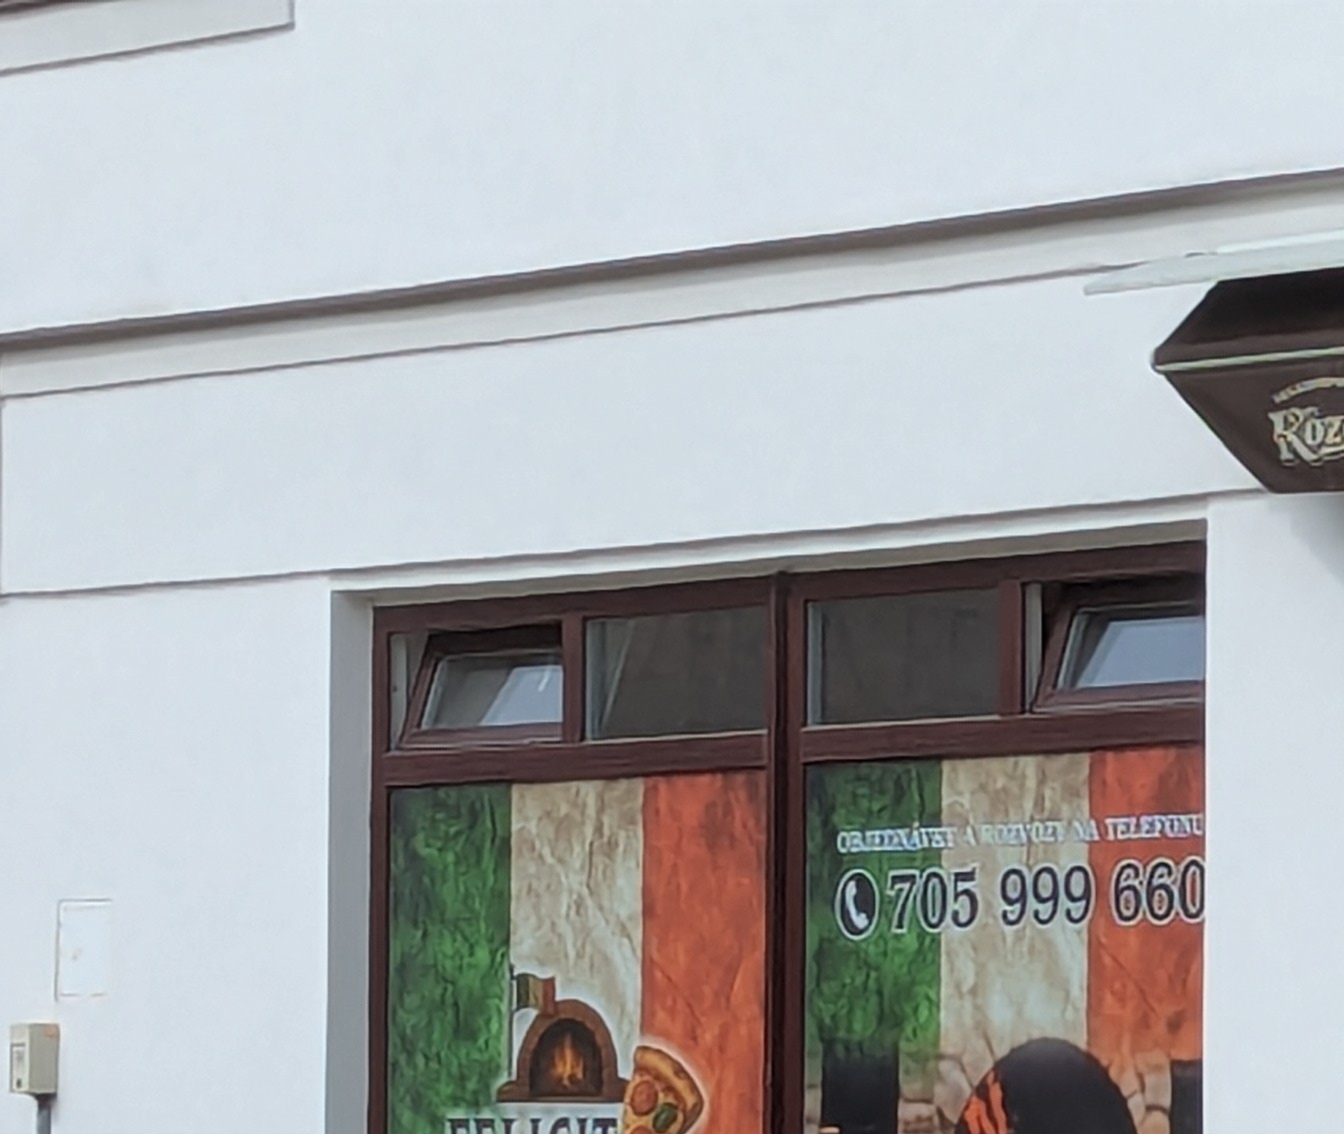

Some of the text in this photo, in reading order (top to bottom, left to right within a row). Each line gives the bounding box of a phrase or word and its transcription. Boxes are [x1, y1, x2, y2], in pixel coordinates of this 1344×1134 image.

[886, 856, 1205, 933] 705 999 660
